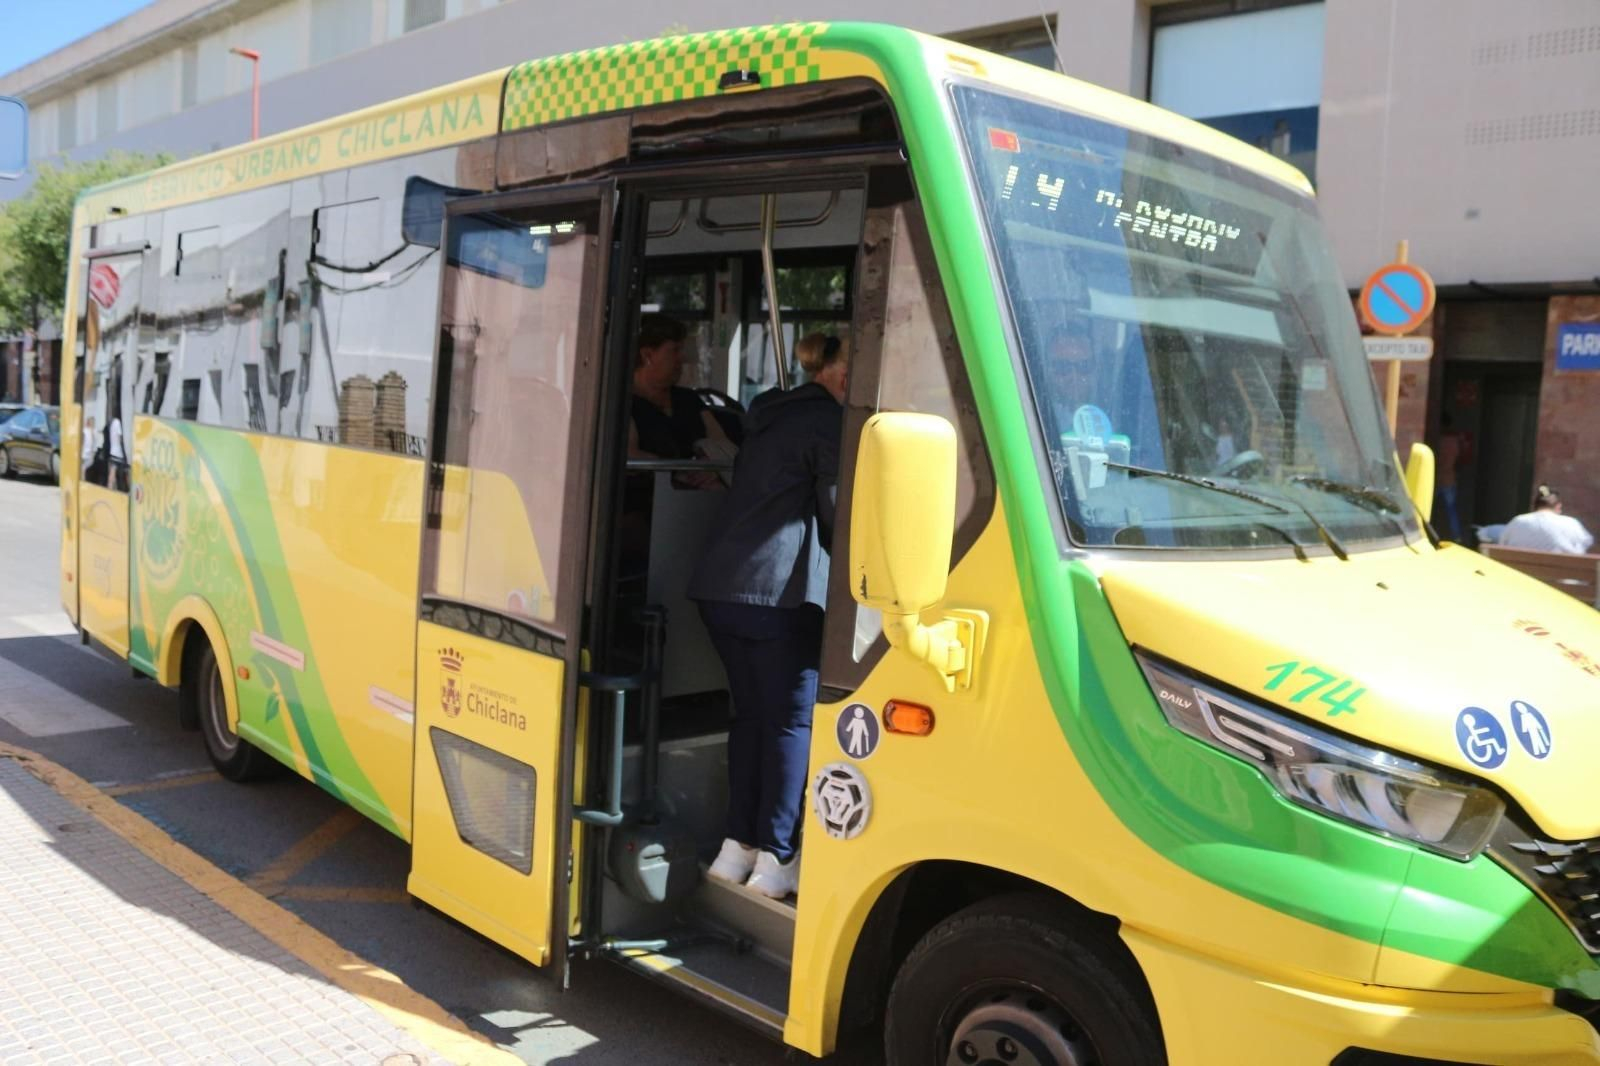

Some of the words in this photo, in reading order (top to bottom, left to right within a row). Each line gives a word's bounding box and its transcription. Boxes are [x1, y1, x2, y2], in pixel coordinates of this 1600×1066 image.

[235, 136, 321, 183] URBANO
[337, 94, 484, 157] CHICLANA
[467, 692, 526, 731] Chiclana
[1160, 690, 1192, 709] DAILY
[1263, 661, 1367, 717] 174
